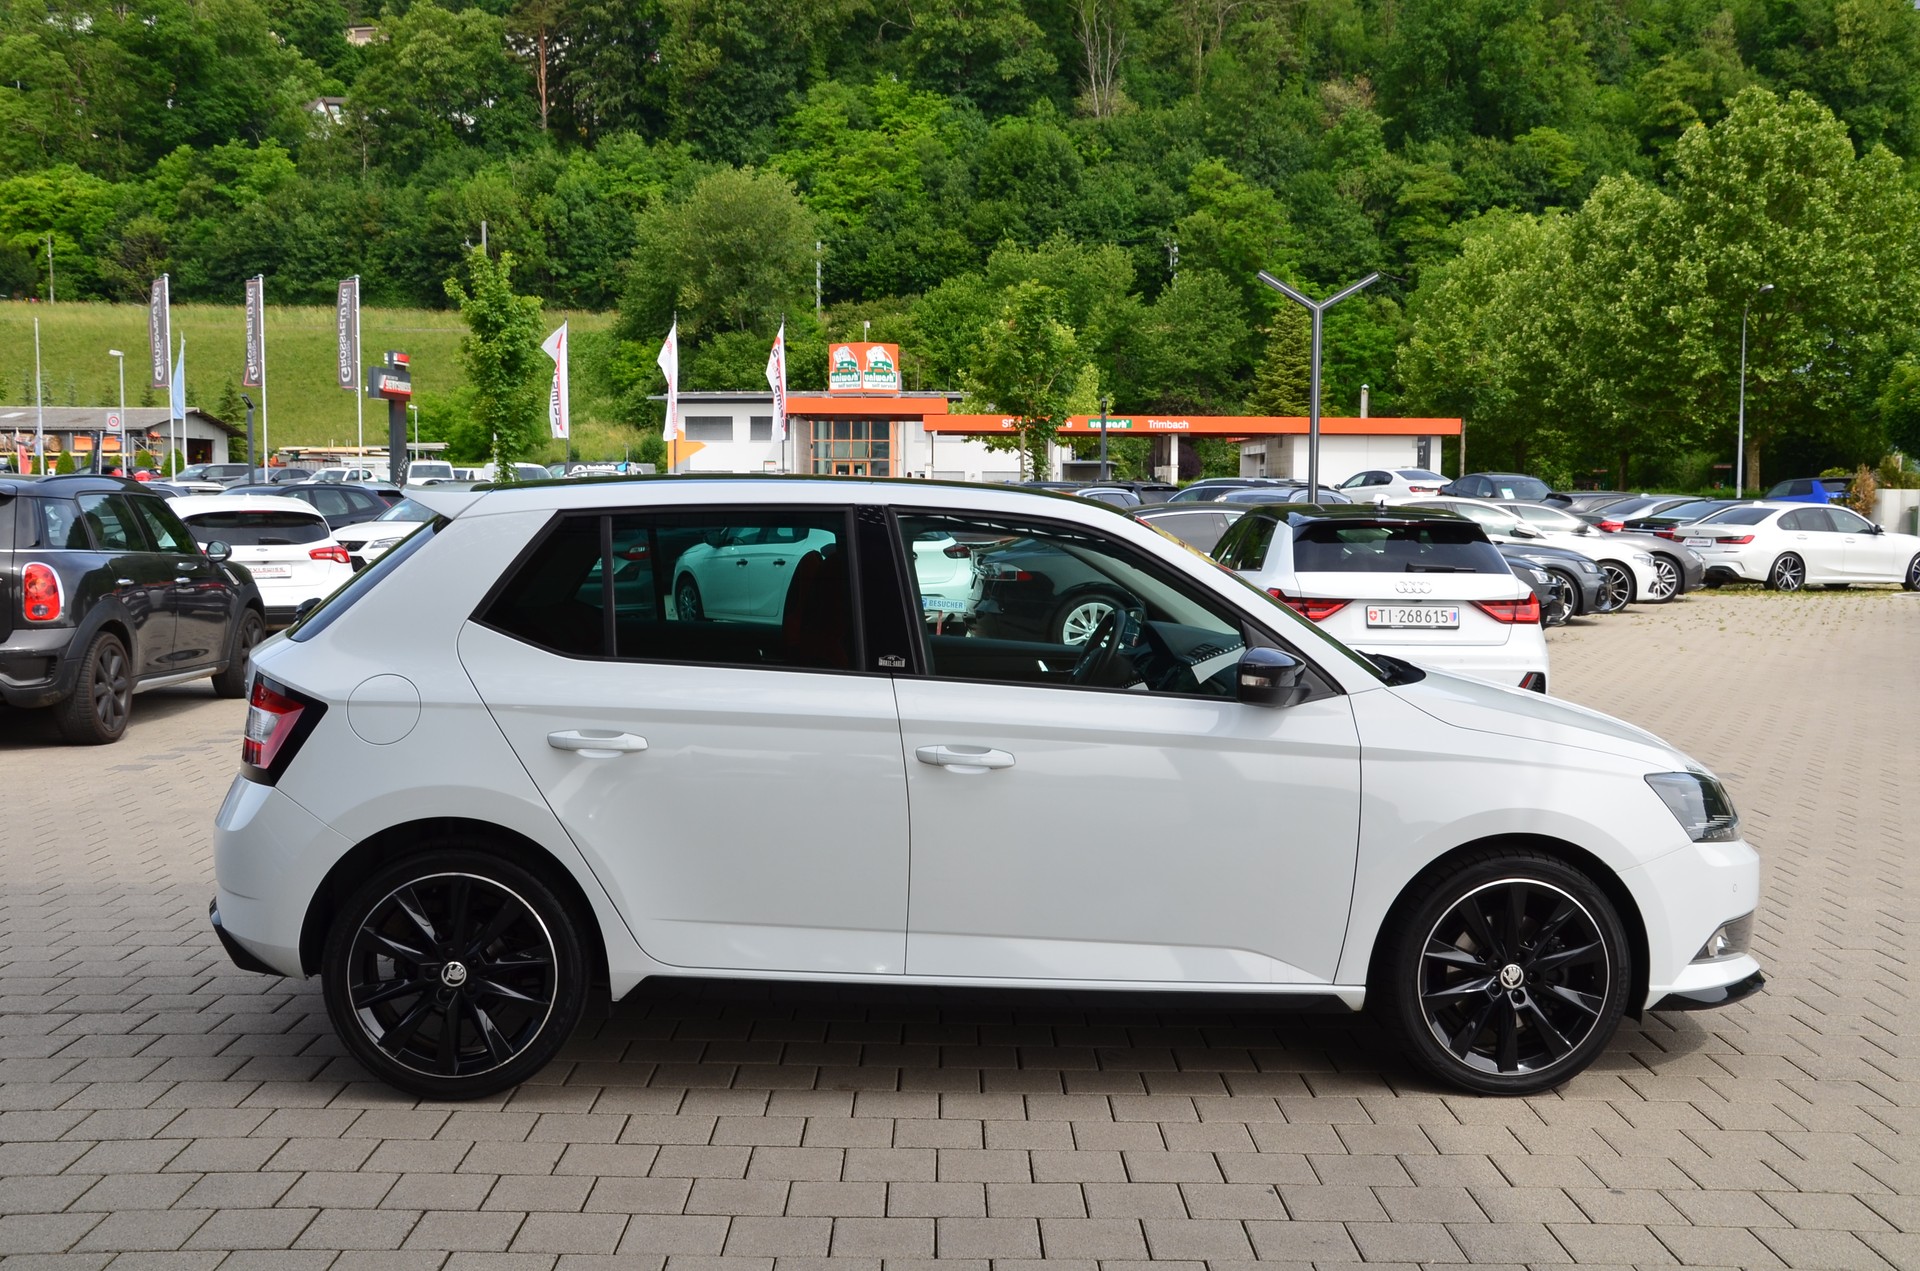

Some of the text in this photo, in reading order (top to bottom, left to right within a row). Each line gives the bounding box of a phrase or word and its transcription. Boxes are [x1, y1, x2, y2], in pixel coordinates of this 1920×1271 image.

[1089, 420, 1127, 428] unwash
[1148, 420, 1189, 429] Trimbach
[929, 599, 964, 609] BESUCHER
